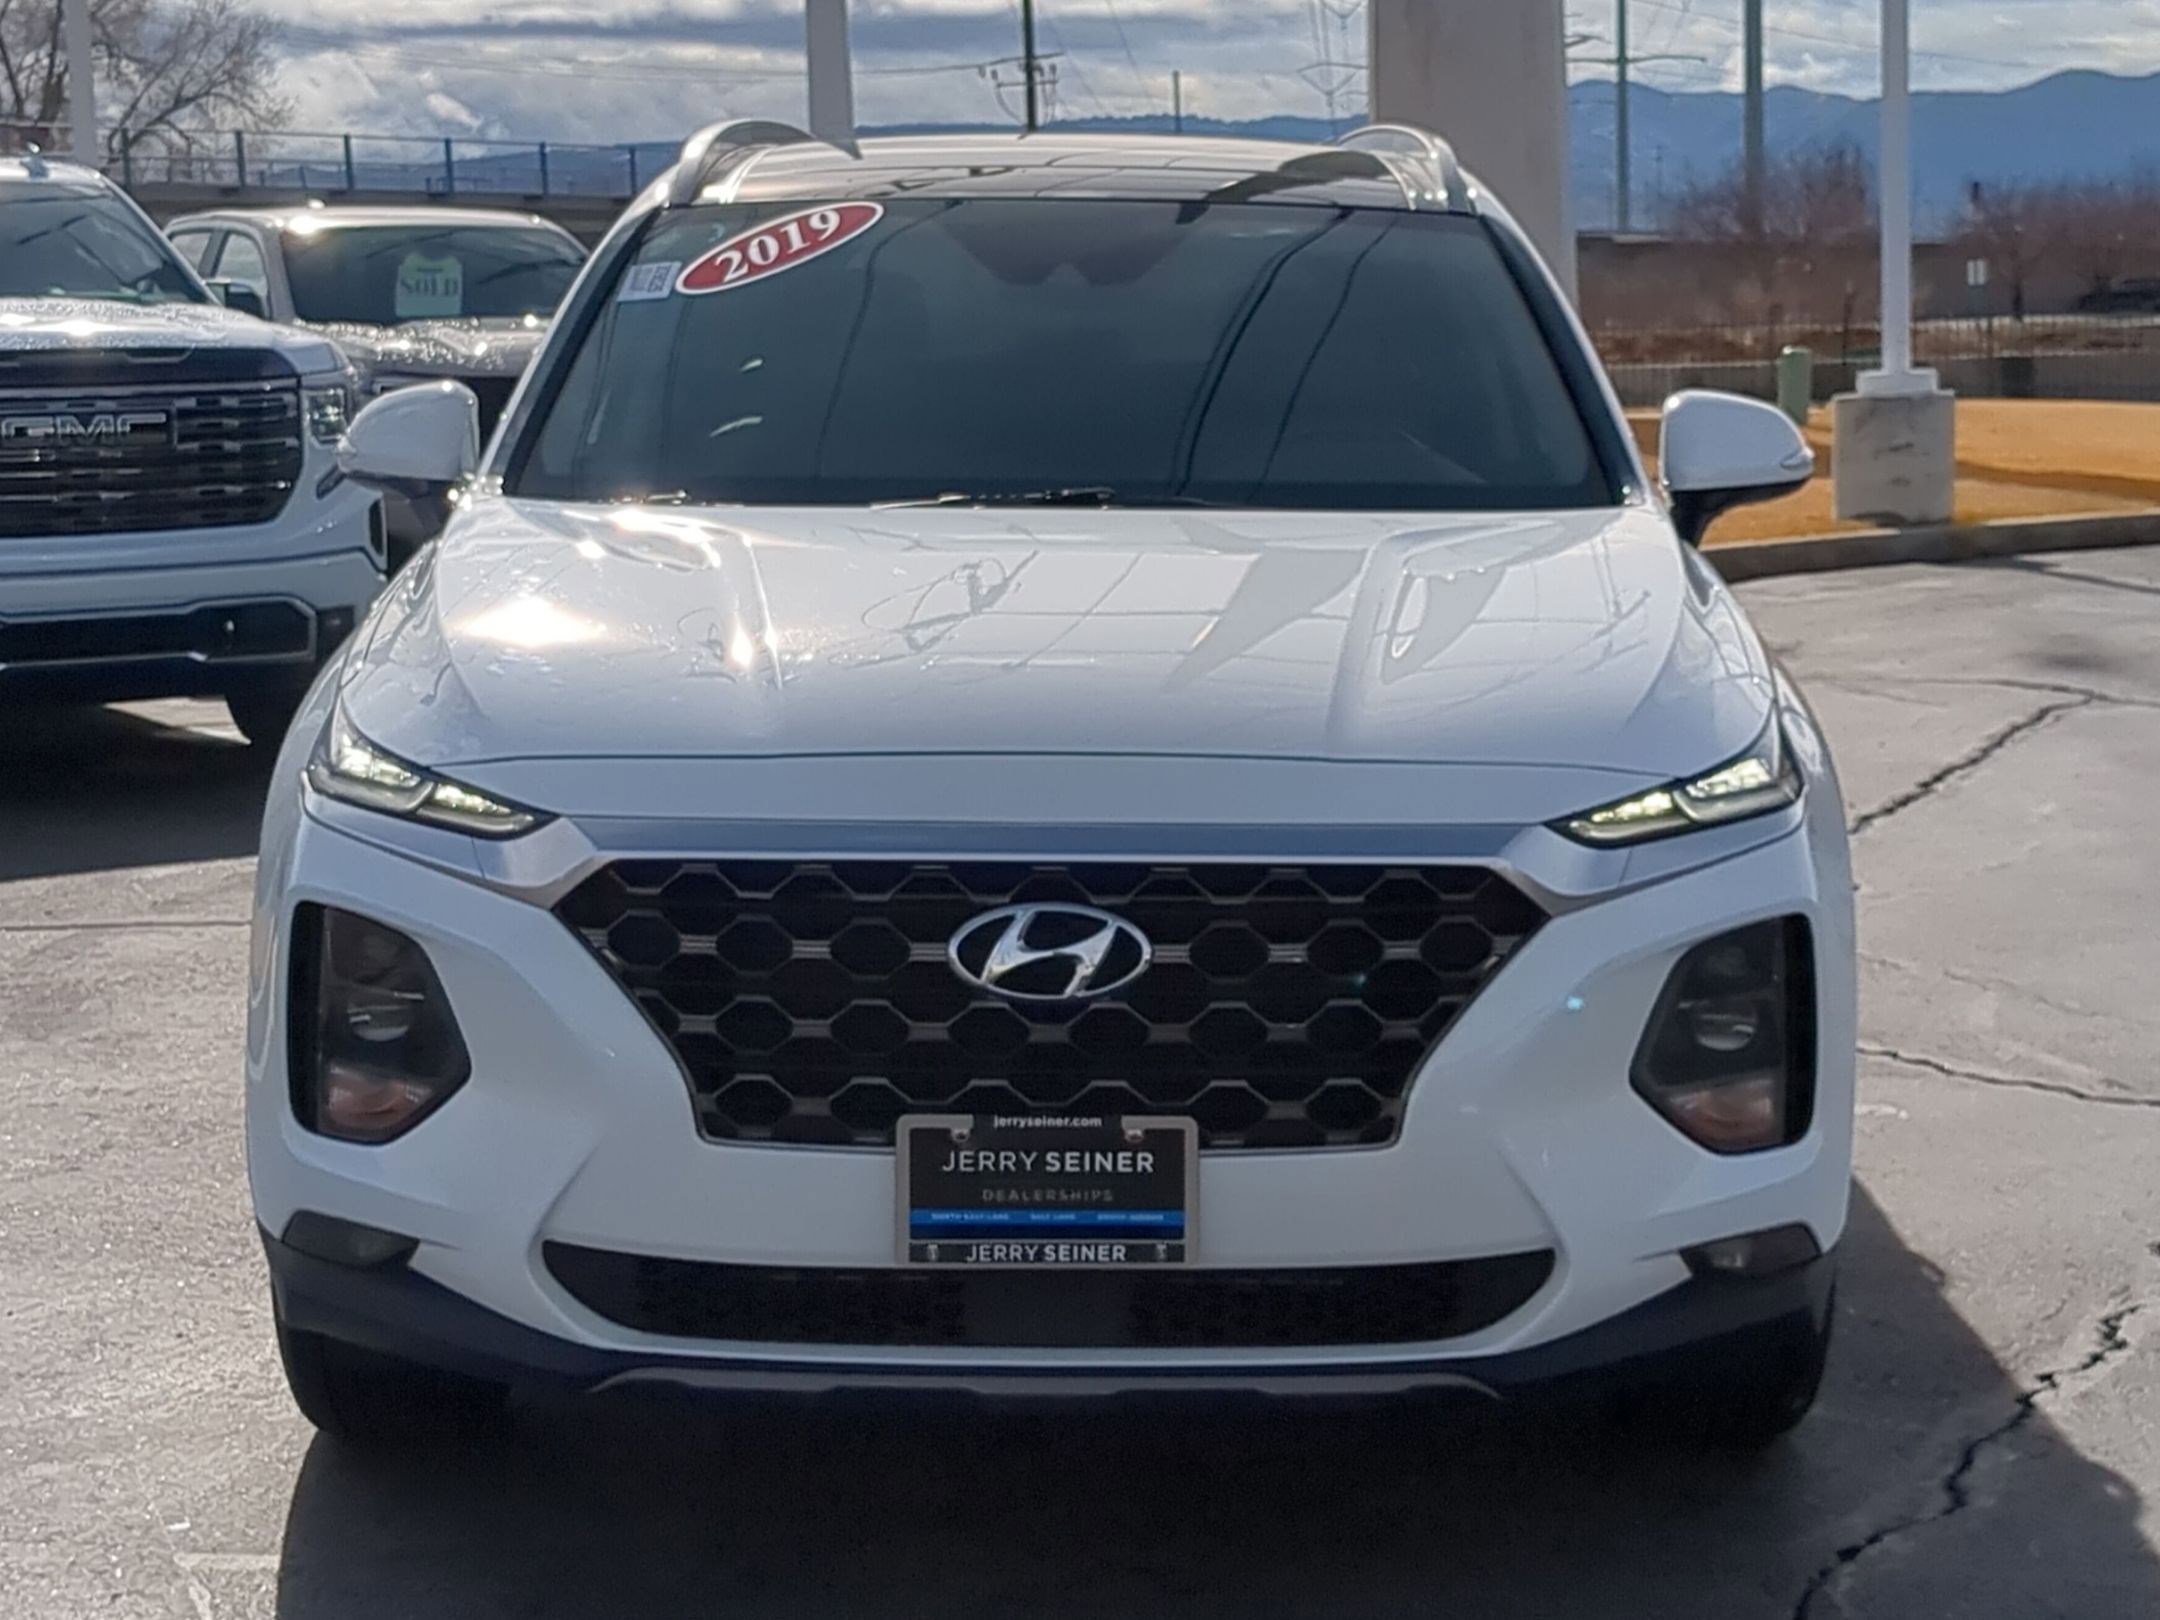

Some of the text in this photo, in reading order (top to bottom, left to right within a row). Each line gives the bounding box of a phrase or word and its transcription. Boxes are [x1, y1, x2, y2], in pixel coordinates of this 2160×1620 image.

[714, 209, 841, 284] 2019
[1, 412, 167, 445] GMC
[993, 1114, 1103, 1129] jerryseiner.com
[942, 1151, 1155, 1173] JERRY SEINER
[982, 1188, 1114, 1202] DEALERSHIPS
[967, 1244, 1127, 1262] JERRY SEINER
